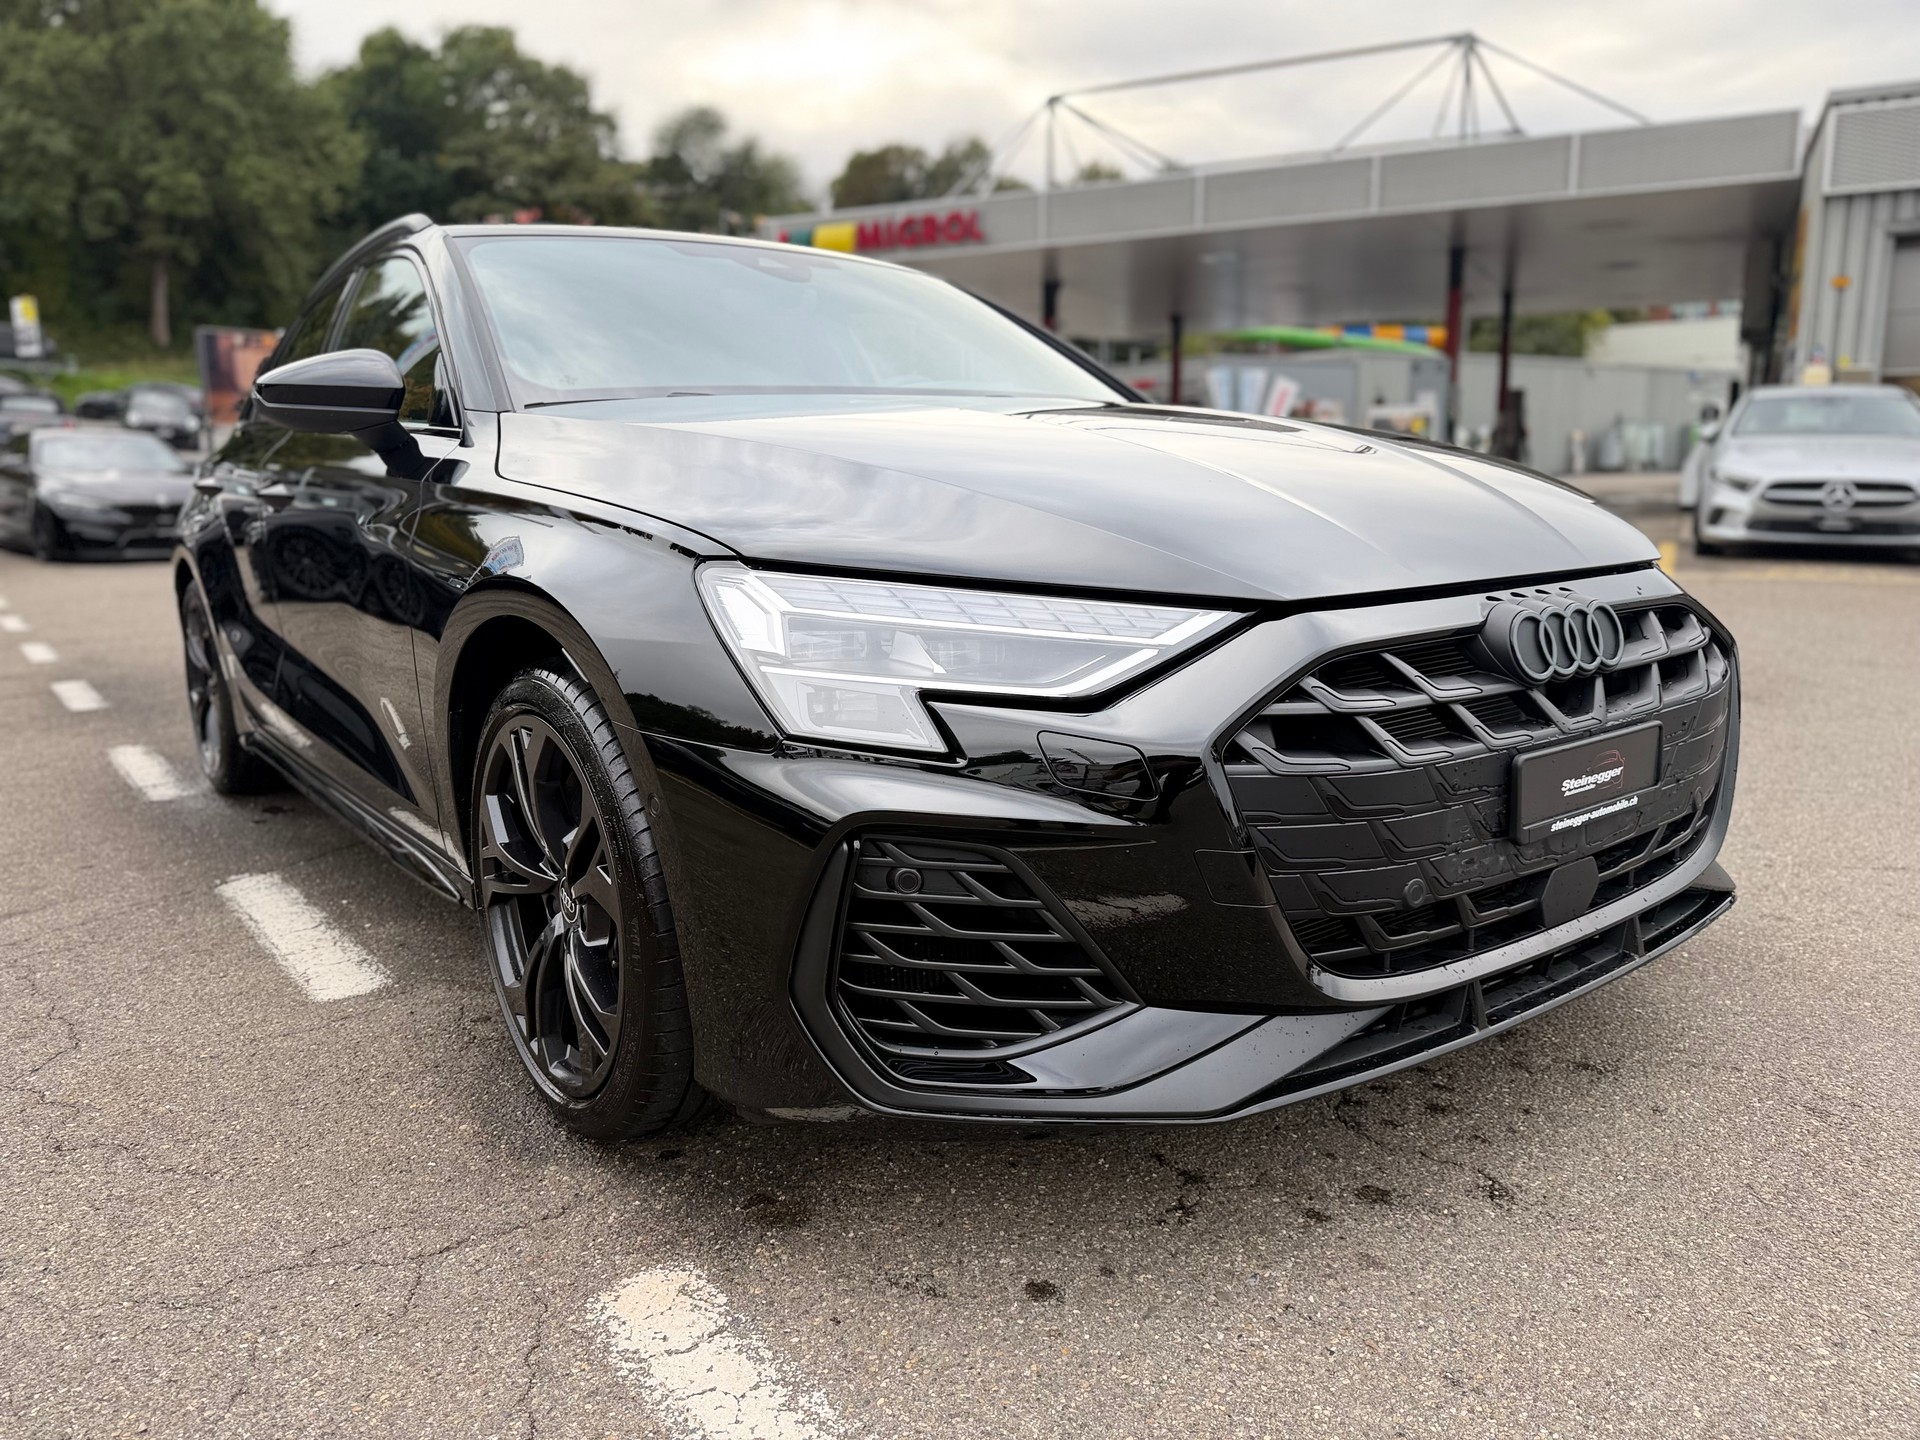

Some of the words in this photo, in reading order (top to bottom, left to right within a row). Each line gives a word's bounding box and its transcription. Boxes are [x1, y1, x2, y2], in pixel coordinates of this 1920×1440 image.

[857, 209, 984, 251] MIGROL
[1561, 766, 1624, 792] Steinegger
[1550, 795, 1639, 832] steinegger-automobile.ch
